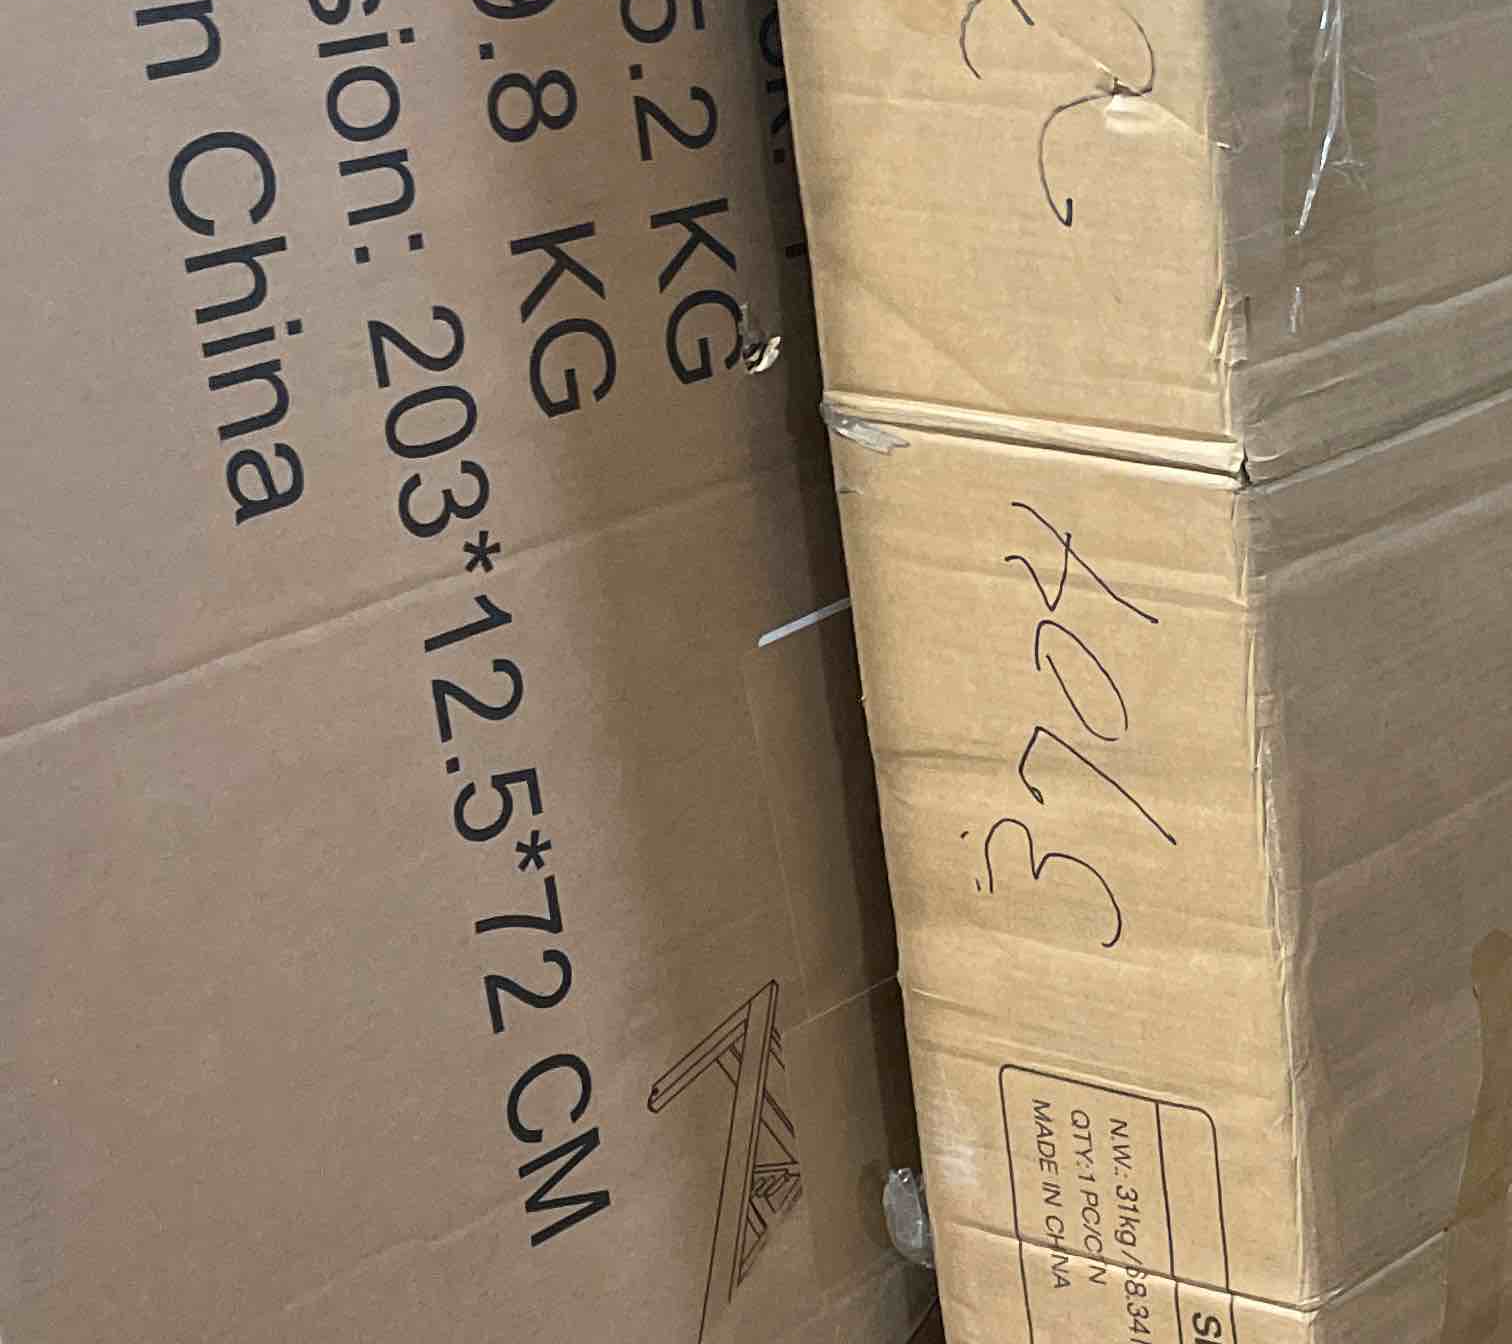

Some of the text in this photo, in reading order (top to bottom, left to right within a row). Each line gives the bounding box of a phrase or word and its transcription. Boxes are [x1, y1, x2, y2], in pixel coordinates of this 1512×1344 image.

[168, 131, 305, 526] China
[510, 221, 617, 419] KG
[650, 197, 747, 386] KG
[984, 500, 1177, 948] 3704
[506, 1052, 611, 1248] CM
[1032, 1099, 1060, 1175] MADE
[1041, 1180, 1064, 1209] IN
